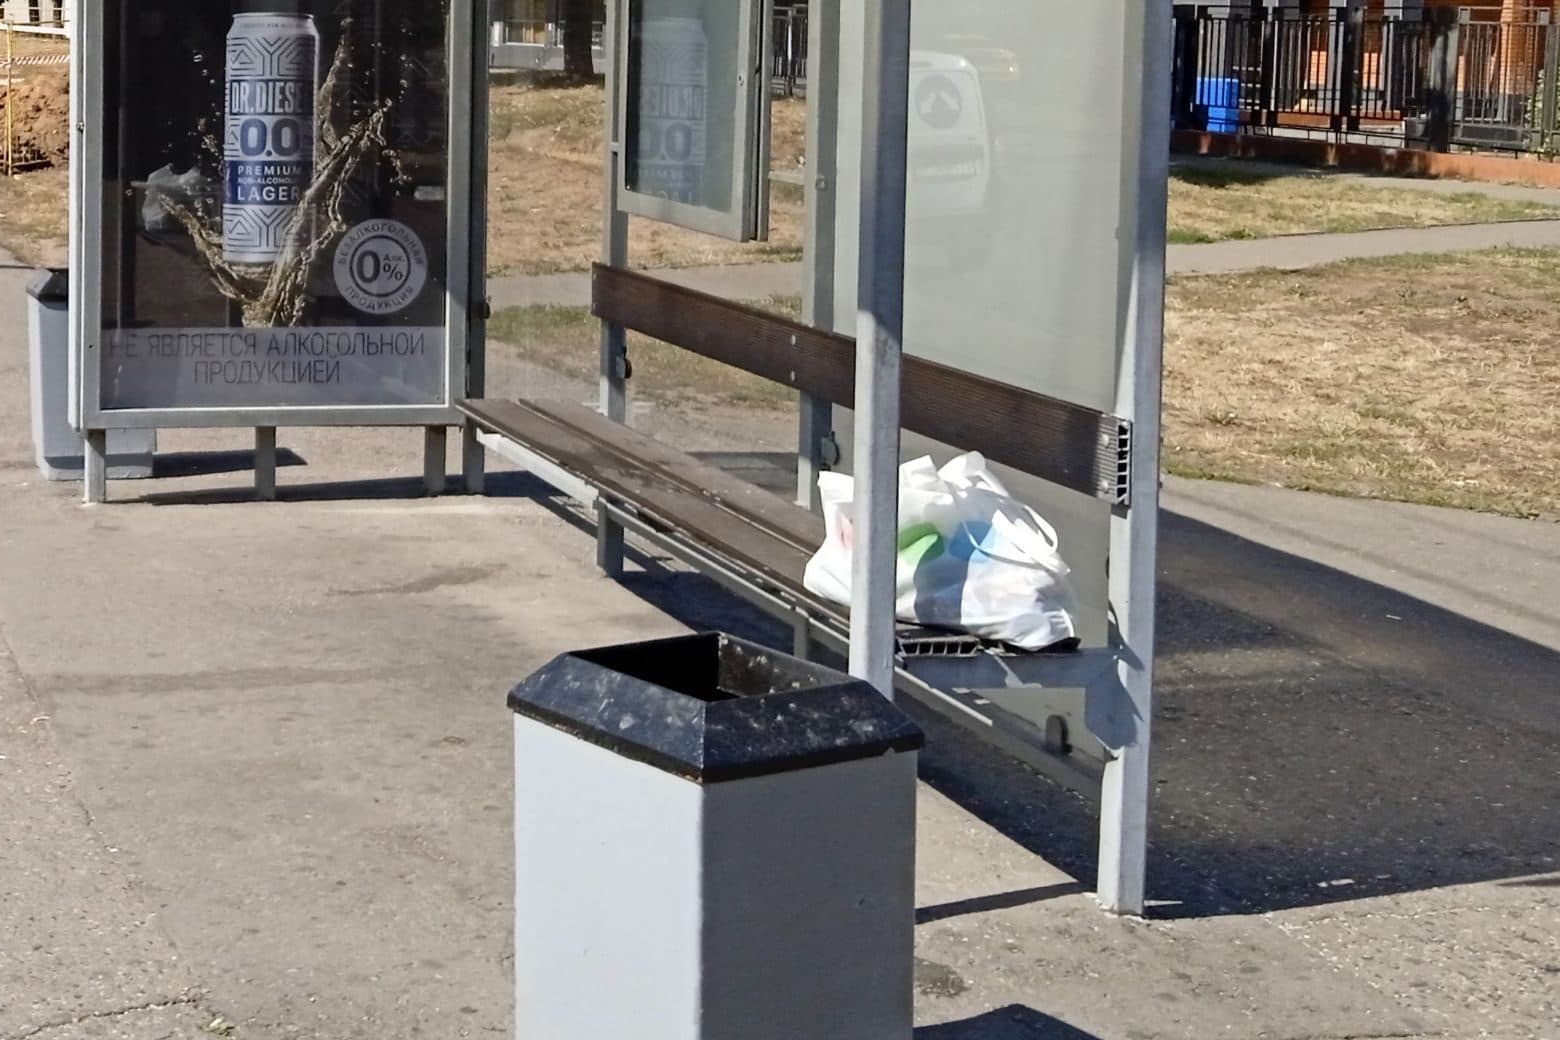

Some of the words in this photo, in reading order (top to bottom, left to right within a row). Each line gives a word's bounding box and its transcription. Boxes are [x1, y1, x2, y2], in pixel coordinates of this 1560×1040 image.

[231, 81, 306, 114] DR.DIESE
[240, 117, 300, 157] 0.0
[237, 165, 301, 176] PREMIUM
[237, 186, 301, 201] LAGER
[109, 333, 137, 357] НЕ
[148, 332, 257, 357] ЯВЛЯЕТСЯ
[266, 328, 425, 357] АЛКОГОЛЬНОЙ
